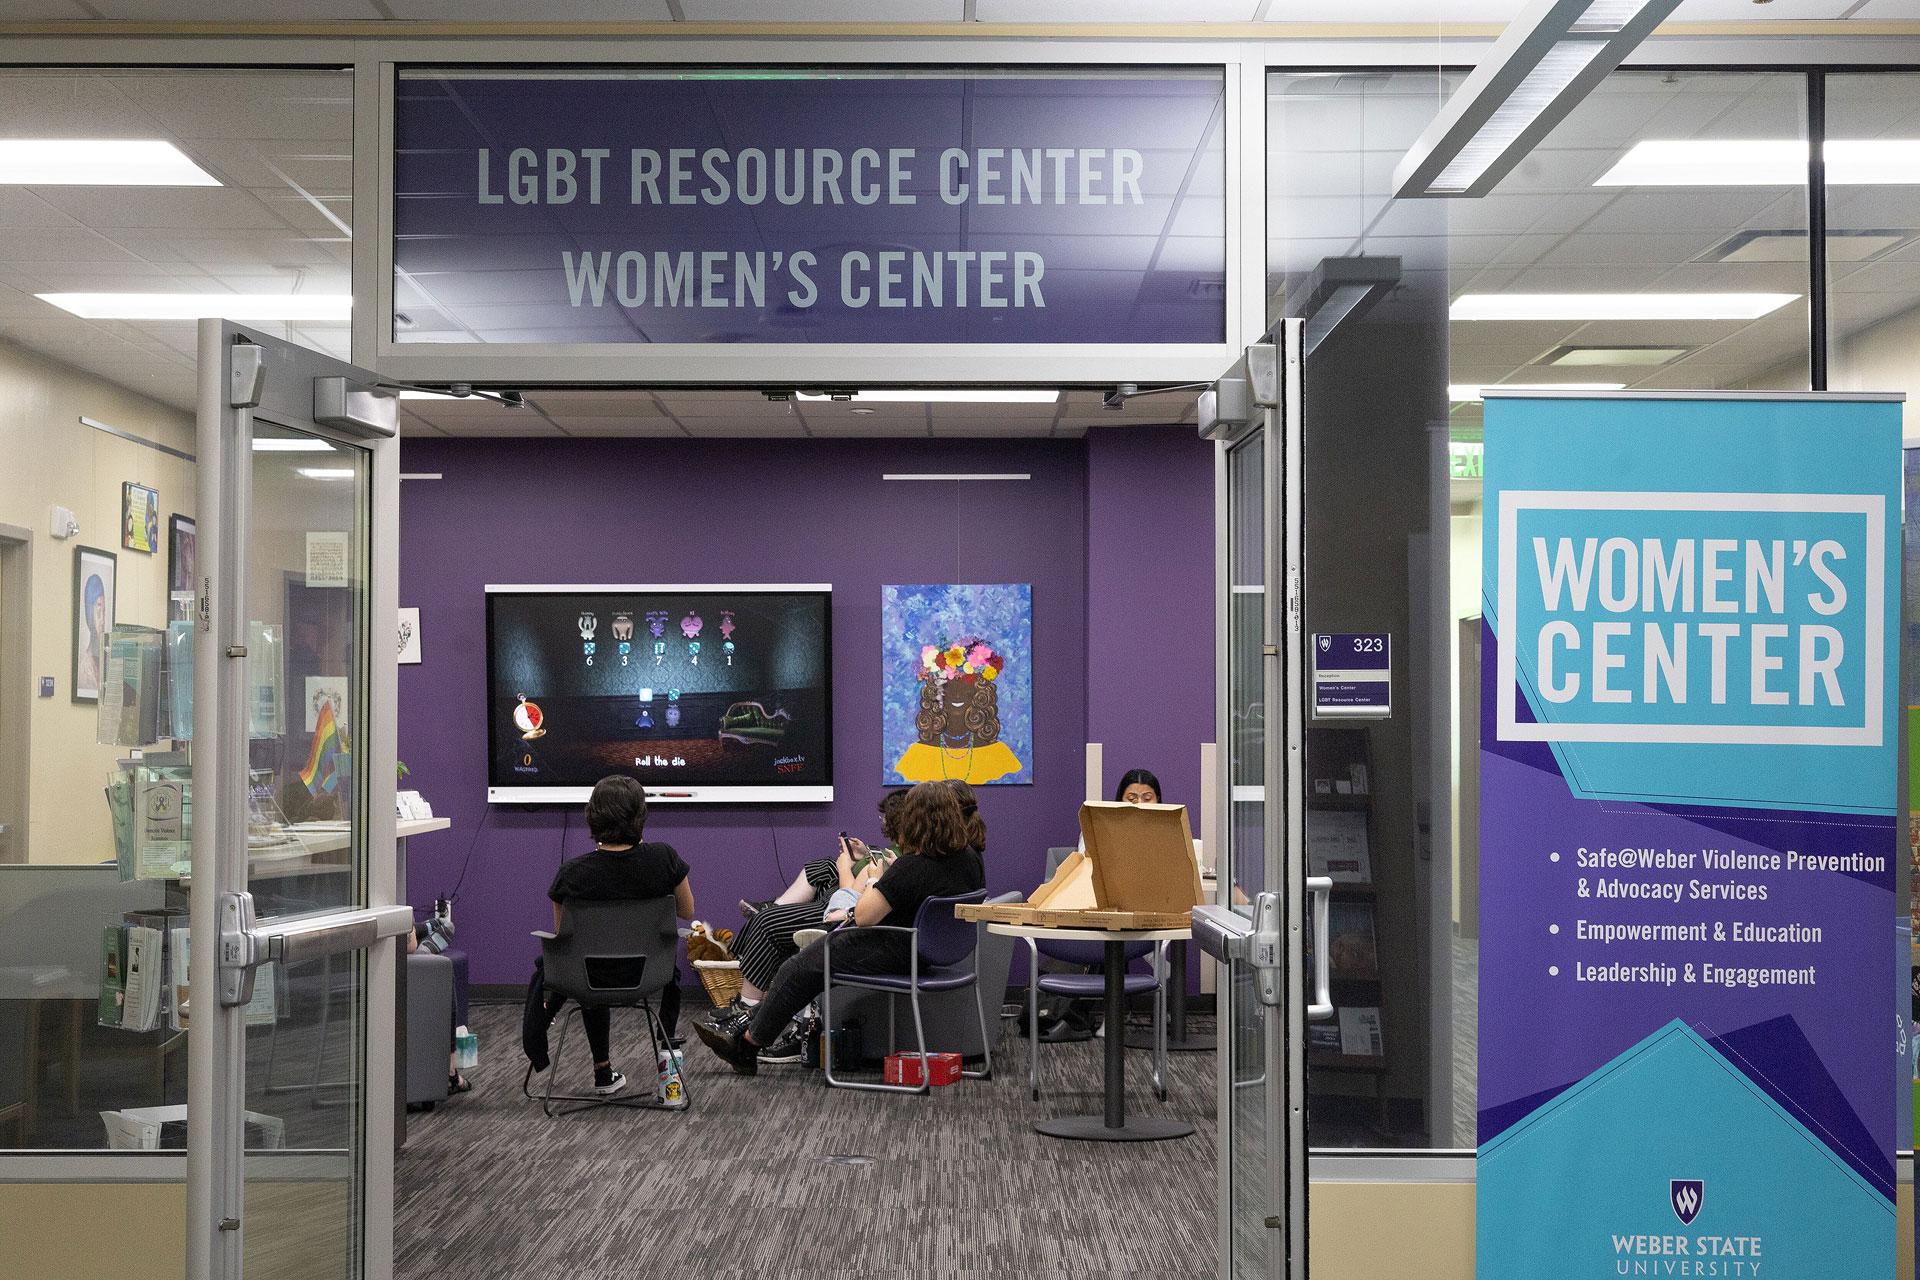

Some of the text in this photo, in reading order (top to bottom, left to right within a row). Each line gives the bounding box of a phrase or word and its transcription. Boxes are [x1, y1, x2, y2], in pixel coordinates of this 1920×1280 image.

[478, 147, 1145, 206] LGBT RESOURCE CENTER
[561, 251, 1046, 308] WOMEN'S CENTER
[1450, 445, 1484, 477] EXI
[1532, 536, 1848, 616] WOMEN'S
[1353, 638, 1383, 652] 323
[586, 656, 732, 666] 6 3 7 4 1
[1537, 620, 1846, 707] CENTER
[523, 753, 532, 767] 0
[635, 755, 686, 766] Roll the die
[1576, 847, 1886, 873] Safe@Weber Violence Prevention
[1577, 878, 1768, 903] & Advocacy Services
[1576, 919, 1822, 944] Empowerment & Education
[1576, 961, 1816, 988] Leadership & Engagement
[1611, 1234, 1762, 1257] WEBER STATE
[1616, 1259, 1761, 1277] UNIVERSITY
